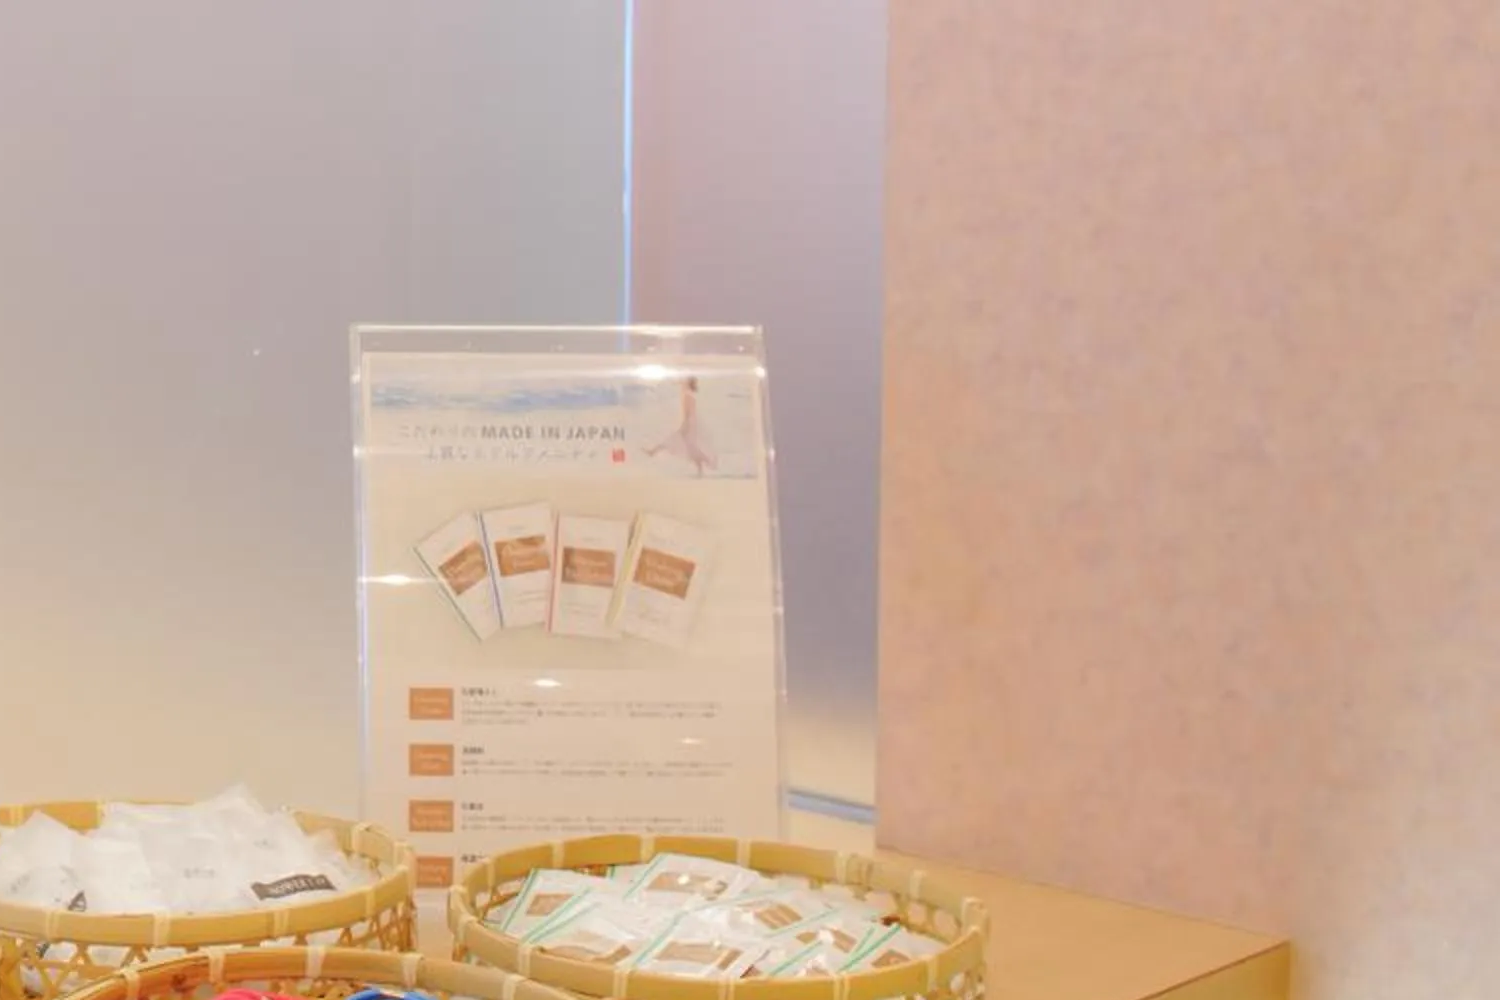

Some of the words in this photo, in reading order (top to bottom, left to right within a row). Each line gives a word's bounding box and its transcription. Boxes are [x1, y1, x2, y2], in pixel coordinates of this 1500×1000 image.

[480, 424, 533, 441] MADE
[540, 425, 561, 441] IN
[565, 425, 626, 442] JAPAN
